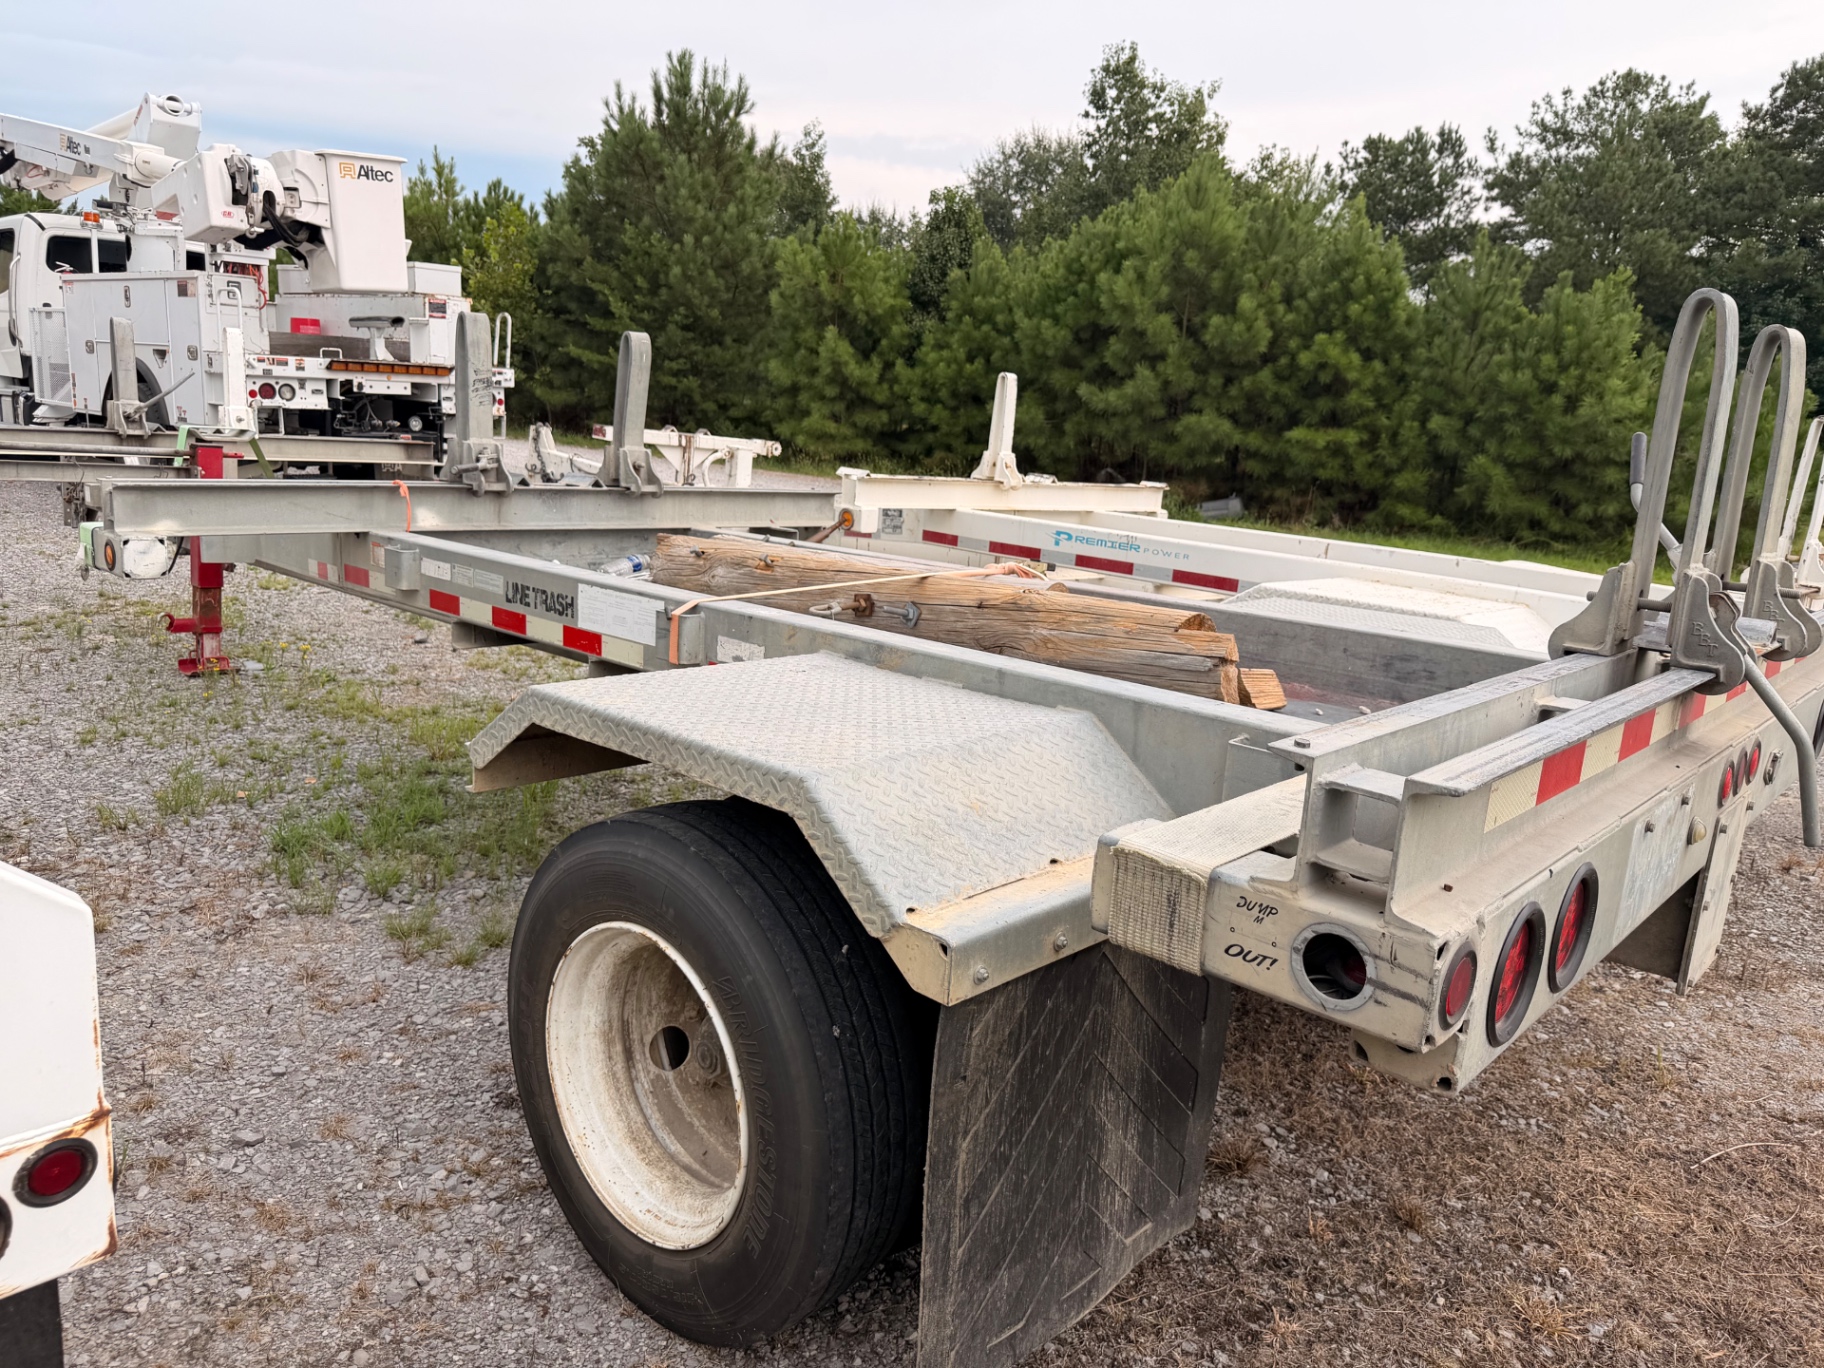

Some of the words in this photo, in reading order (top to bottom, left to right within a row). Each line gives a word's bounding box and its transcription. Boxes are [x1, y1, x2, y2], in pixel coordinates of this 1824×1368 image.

[357, 164, 393, 182] Altec
[1053, 530, 1141, 553] PREMIER
[1143, 547, 1190, 560] POWER
[505, 580, 531, 608] LINE
[532, 586, 575, 619] TRASH
[1691, 621, 1719, 657] BBT
[1224, 943, 1279, 971] OUT!
[713, 975, 778, 1260] BRIDGESTONE
